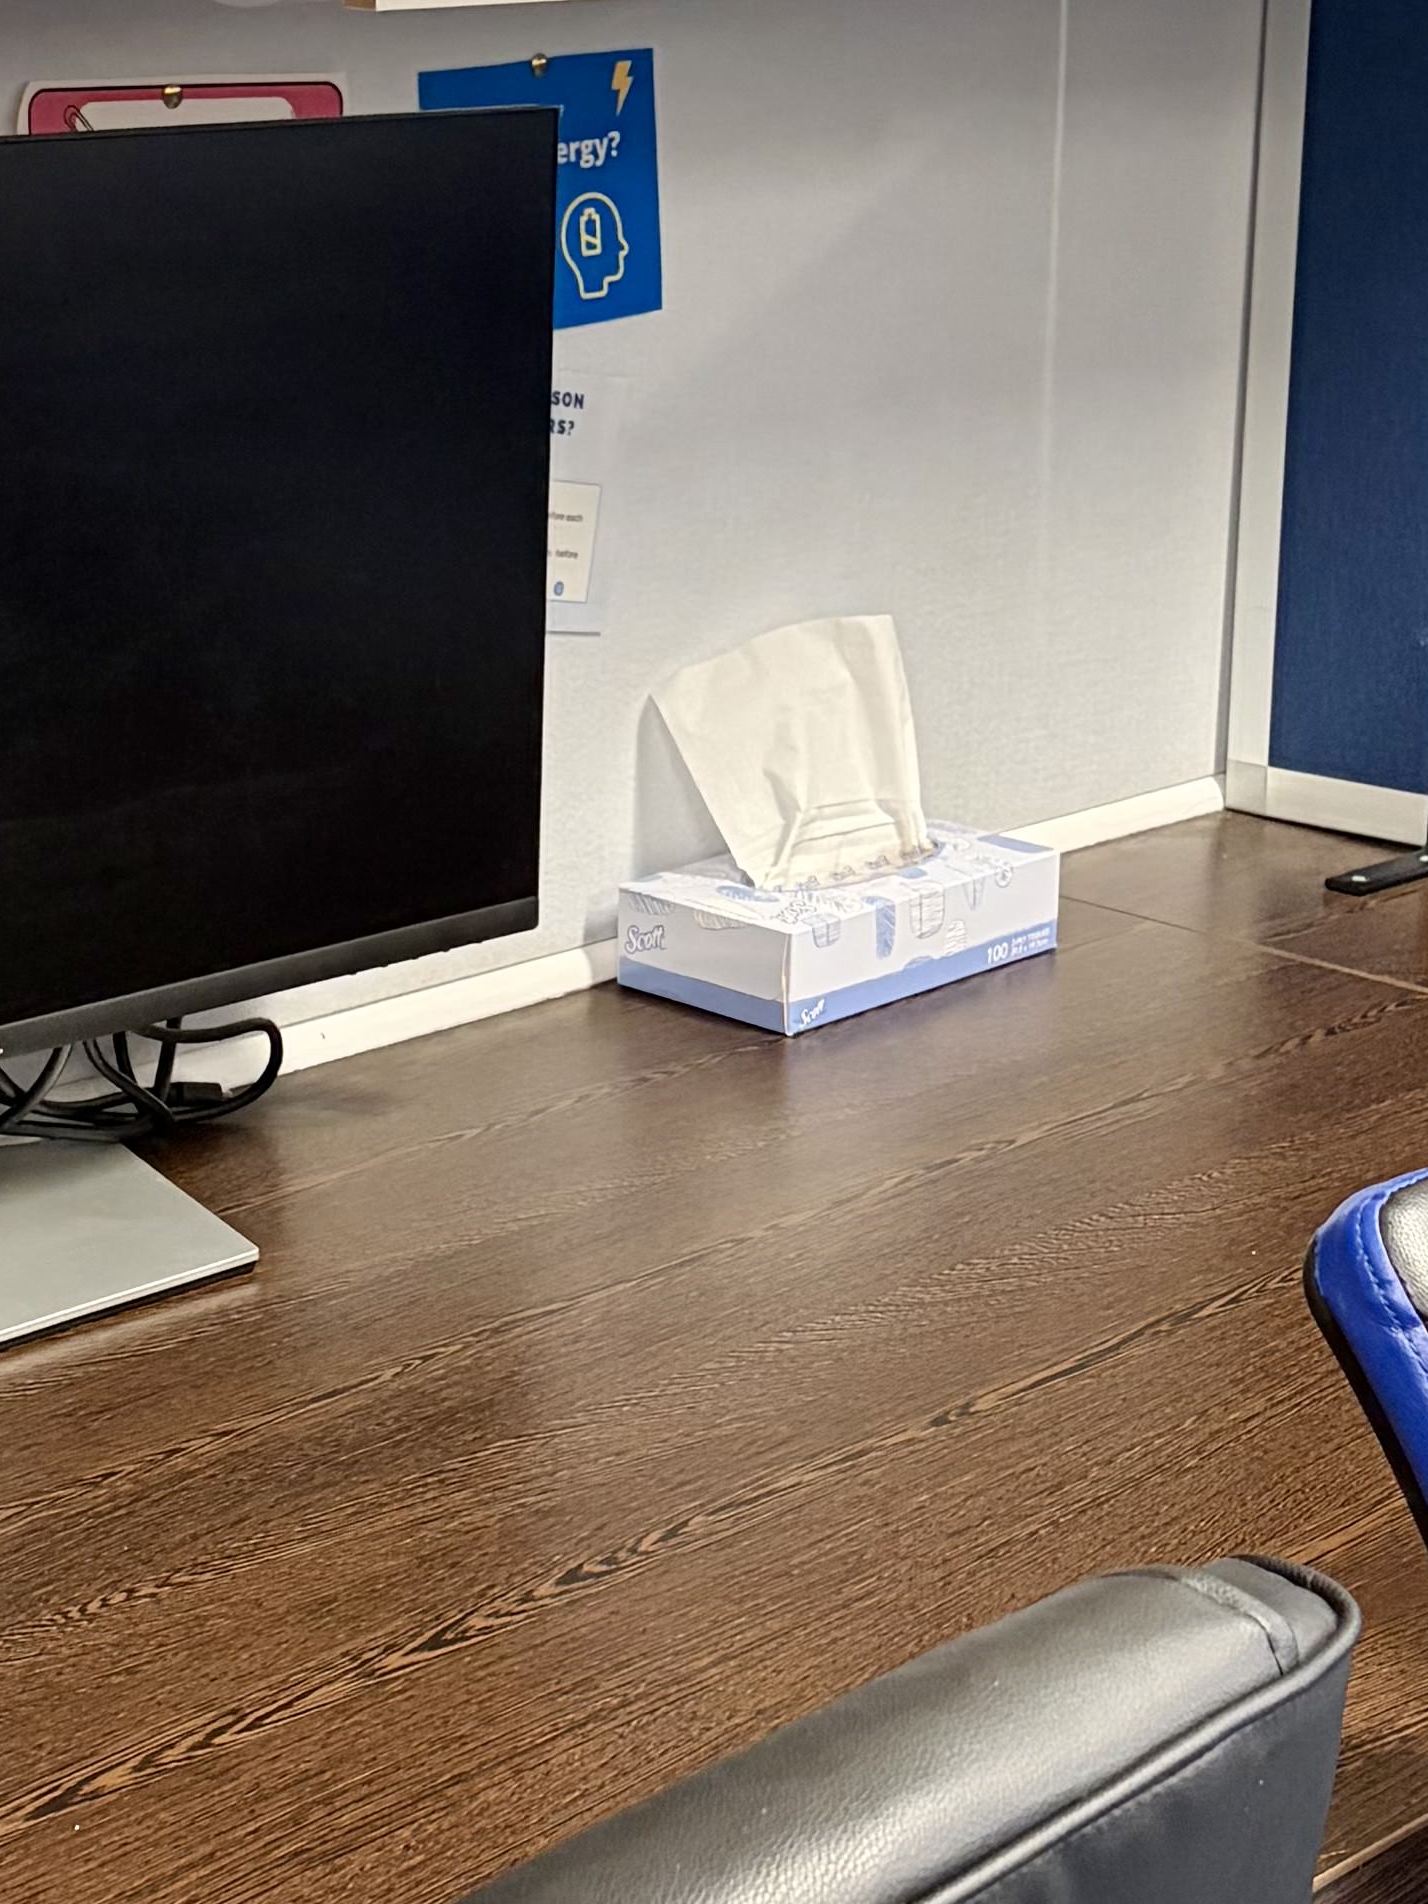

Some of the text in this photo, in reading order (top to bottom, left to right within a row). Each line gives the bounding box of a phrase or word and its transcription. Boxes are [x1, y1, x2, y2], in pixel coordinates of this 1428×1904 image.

[557, 132, 620, 169] ergy?
[551, 391, 584, 409] SON
[626, 925, 667, 954] Scott
[987, 942, 1009, 964] 100
[800, 999, 826, 1027] Scott
